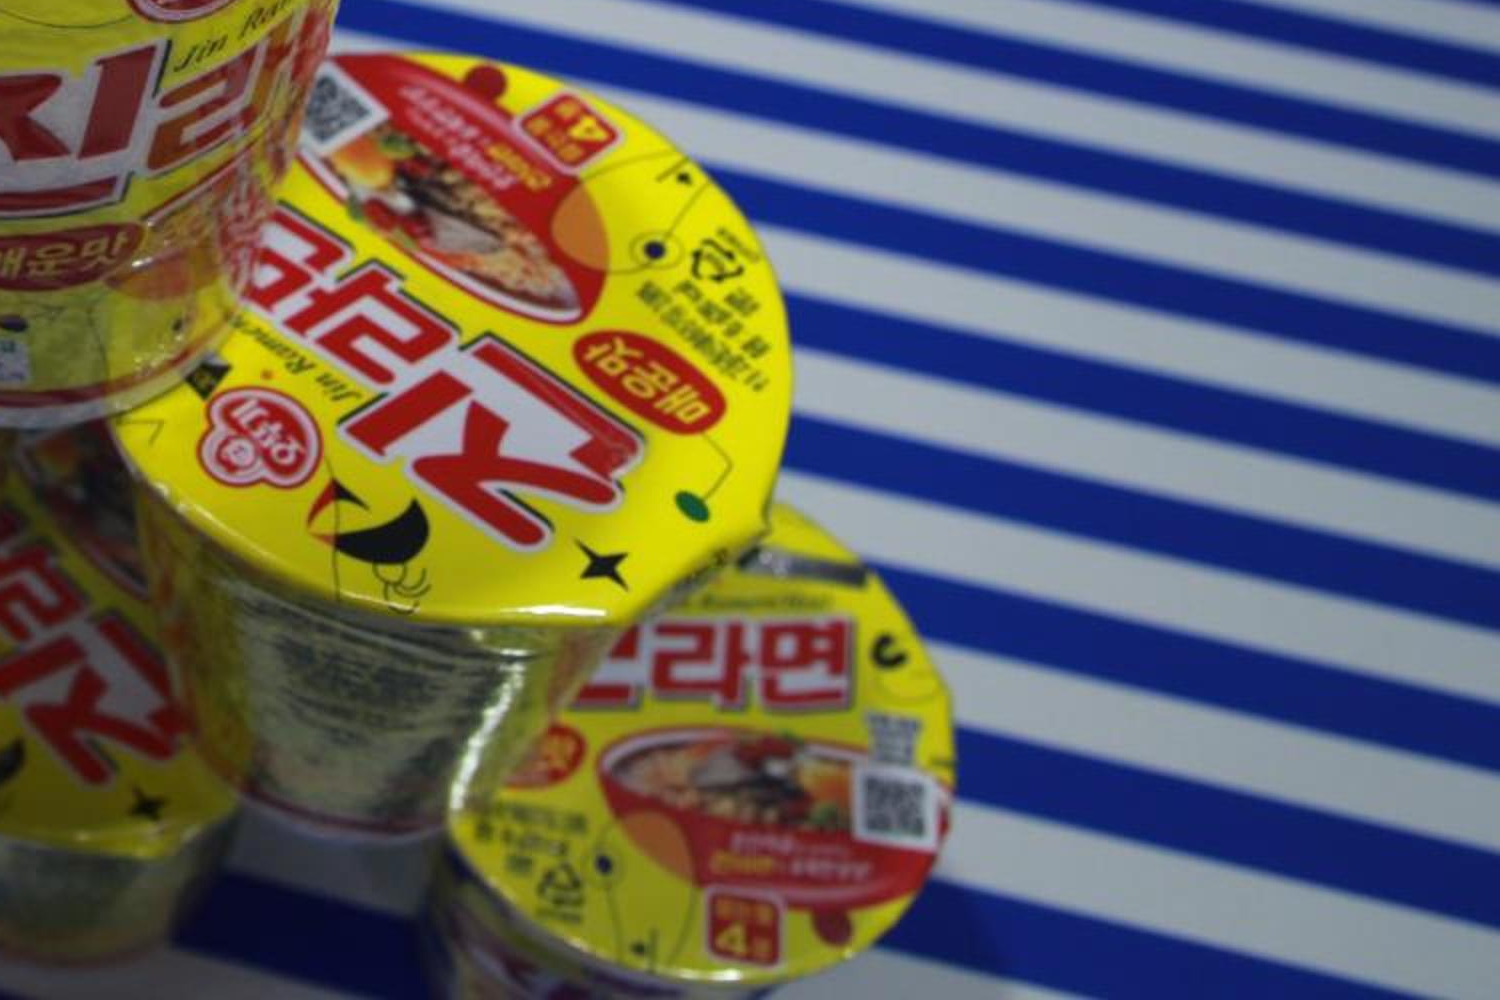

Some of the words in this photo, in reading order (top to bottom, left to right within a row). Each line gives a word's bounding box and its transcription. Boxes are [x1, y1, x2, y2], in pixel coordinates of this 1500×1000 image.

[172, 36, 228, 74] Jin
[316, 370, 364, 403] Jin
[586, 335, 714, 426] 매운맛
[230, 399, 304, 466] 오뚜기
